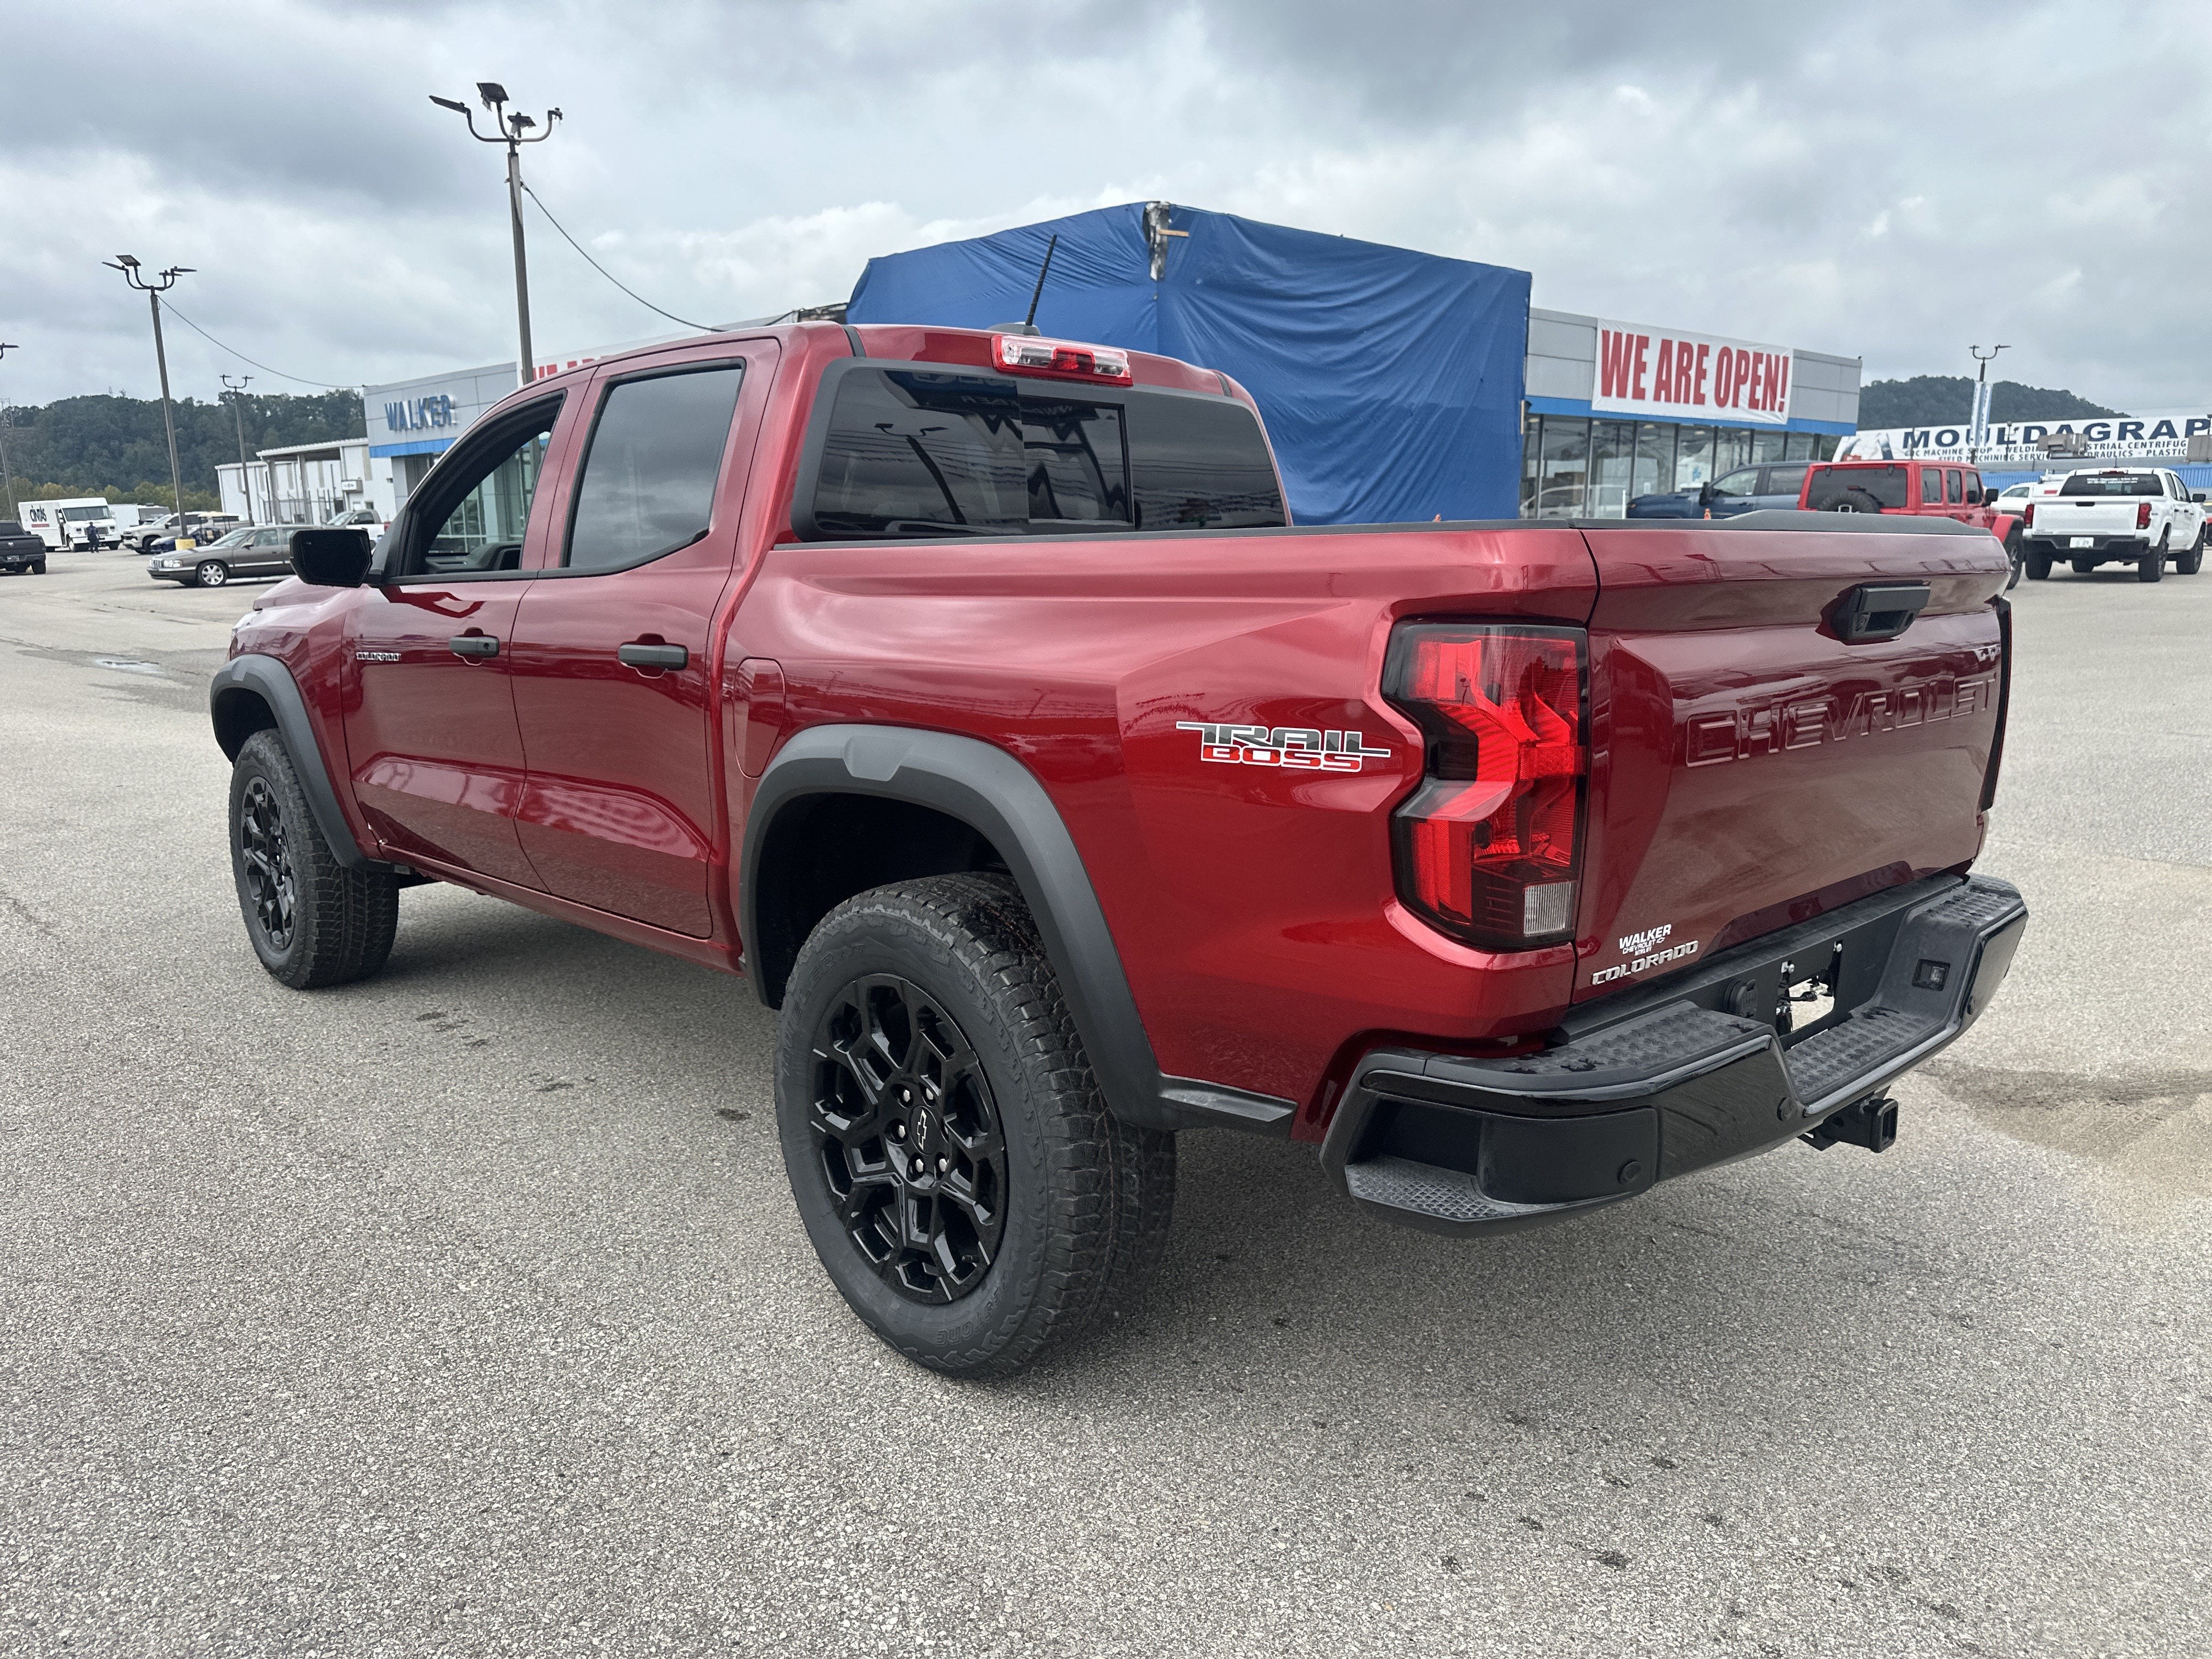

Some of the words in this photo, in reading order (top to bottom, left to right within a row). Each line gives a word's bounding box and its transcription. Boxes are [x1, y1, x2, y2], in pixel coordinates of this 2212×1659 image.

[1601, 329, 1650, 400] WE
[1653, 338, 1710, 405] ARE
[1714, 346, 1789, 413] OPEN!
[385, 394, 453, 431] WALKER
[1923, 448, 1963, 456] MACHINE
[1686, 672, 1996, 768] CHEVROLET
[1176, 721, 1391, 758] TRAIL
[1200, 744, 1363, 772] BOSS
[1620, 924, 1672, 950] WALKER
[1622, 939, 1656, 955] CHEVROLET
[1592, 940, 1699, 985] COLORADO
